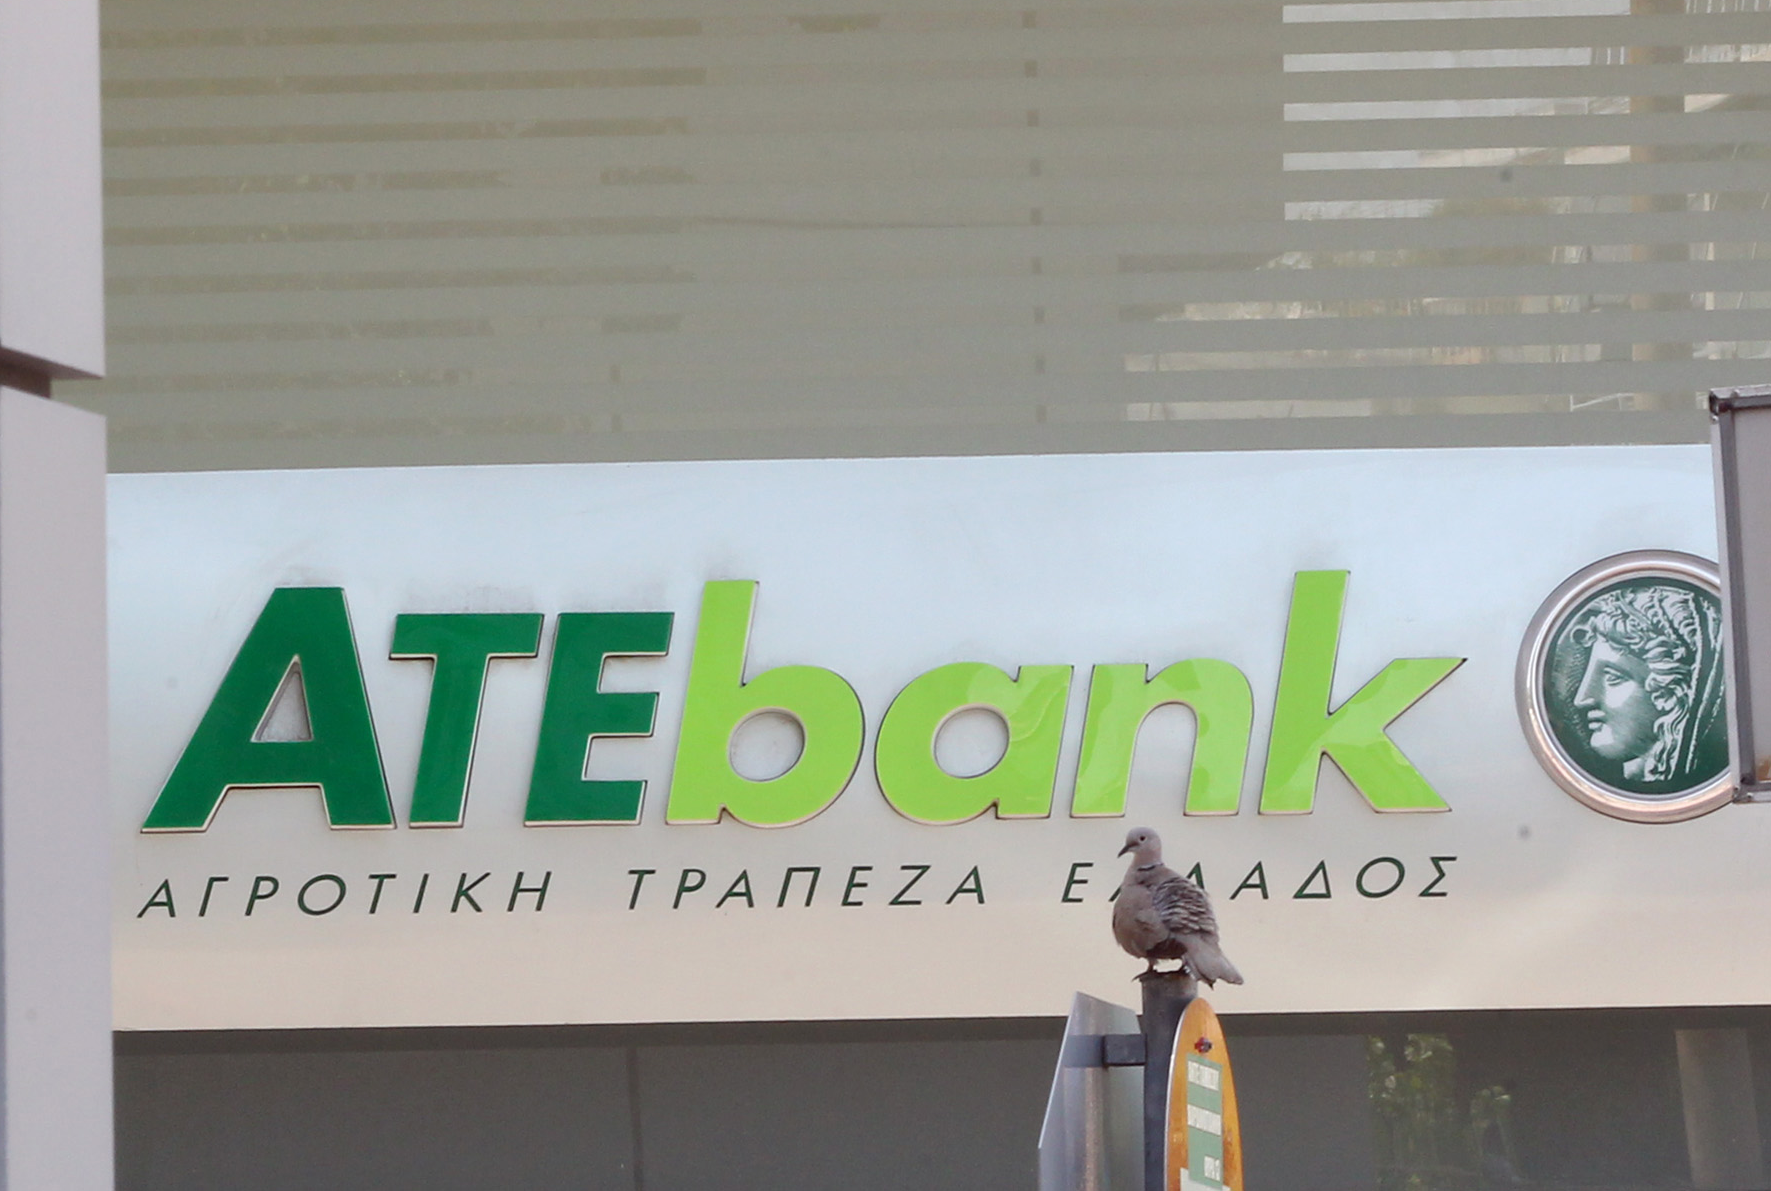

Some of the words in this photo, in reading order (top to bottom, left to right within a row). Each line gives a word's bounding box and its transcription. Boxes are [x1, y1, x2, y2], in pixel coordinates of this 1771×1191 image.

[140, 569, 1468, 831] ATEbank
[137, 871, 552, 918] ΑΓΡΟΤΙΚΗ
[628, 865, 985, 909] ΤΡΑΠΕΖΑ
[1061, 856, 1457, 903] ΕΛΑΔΟΣ
